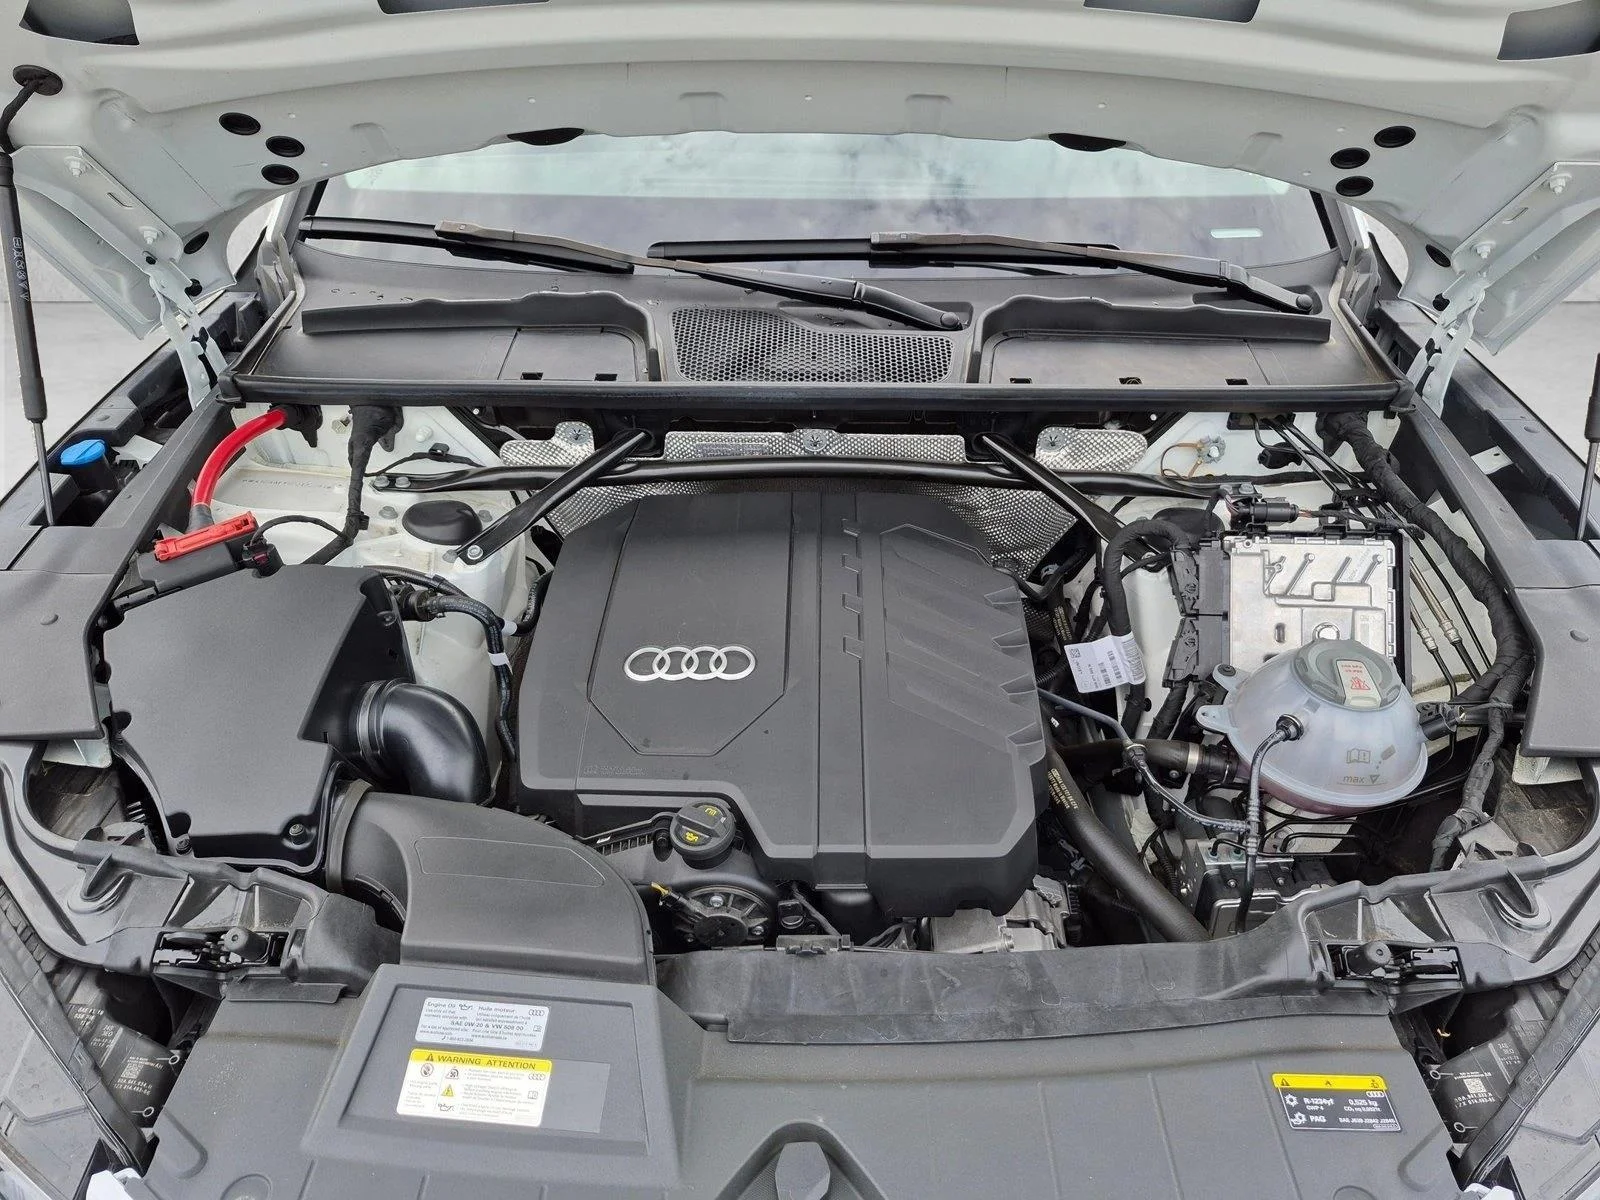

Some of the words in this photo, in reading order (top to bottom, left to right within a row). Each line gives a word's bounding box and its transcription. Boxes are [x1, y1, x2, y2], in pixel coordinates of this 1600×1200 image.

[1343, 775, 1365, 784] max
[437, 1055, 481, 1066] WARNING
[486, 1059, 536, 1070] ATTENTION
[1309, 1115, 1326, 1123] PAG
